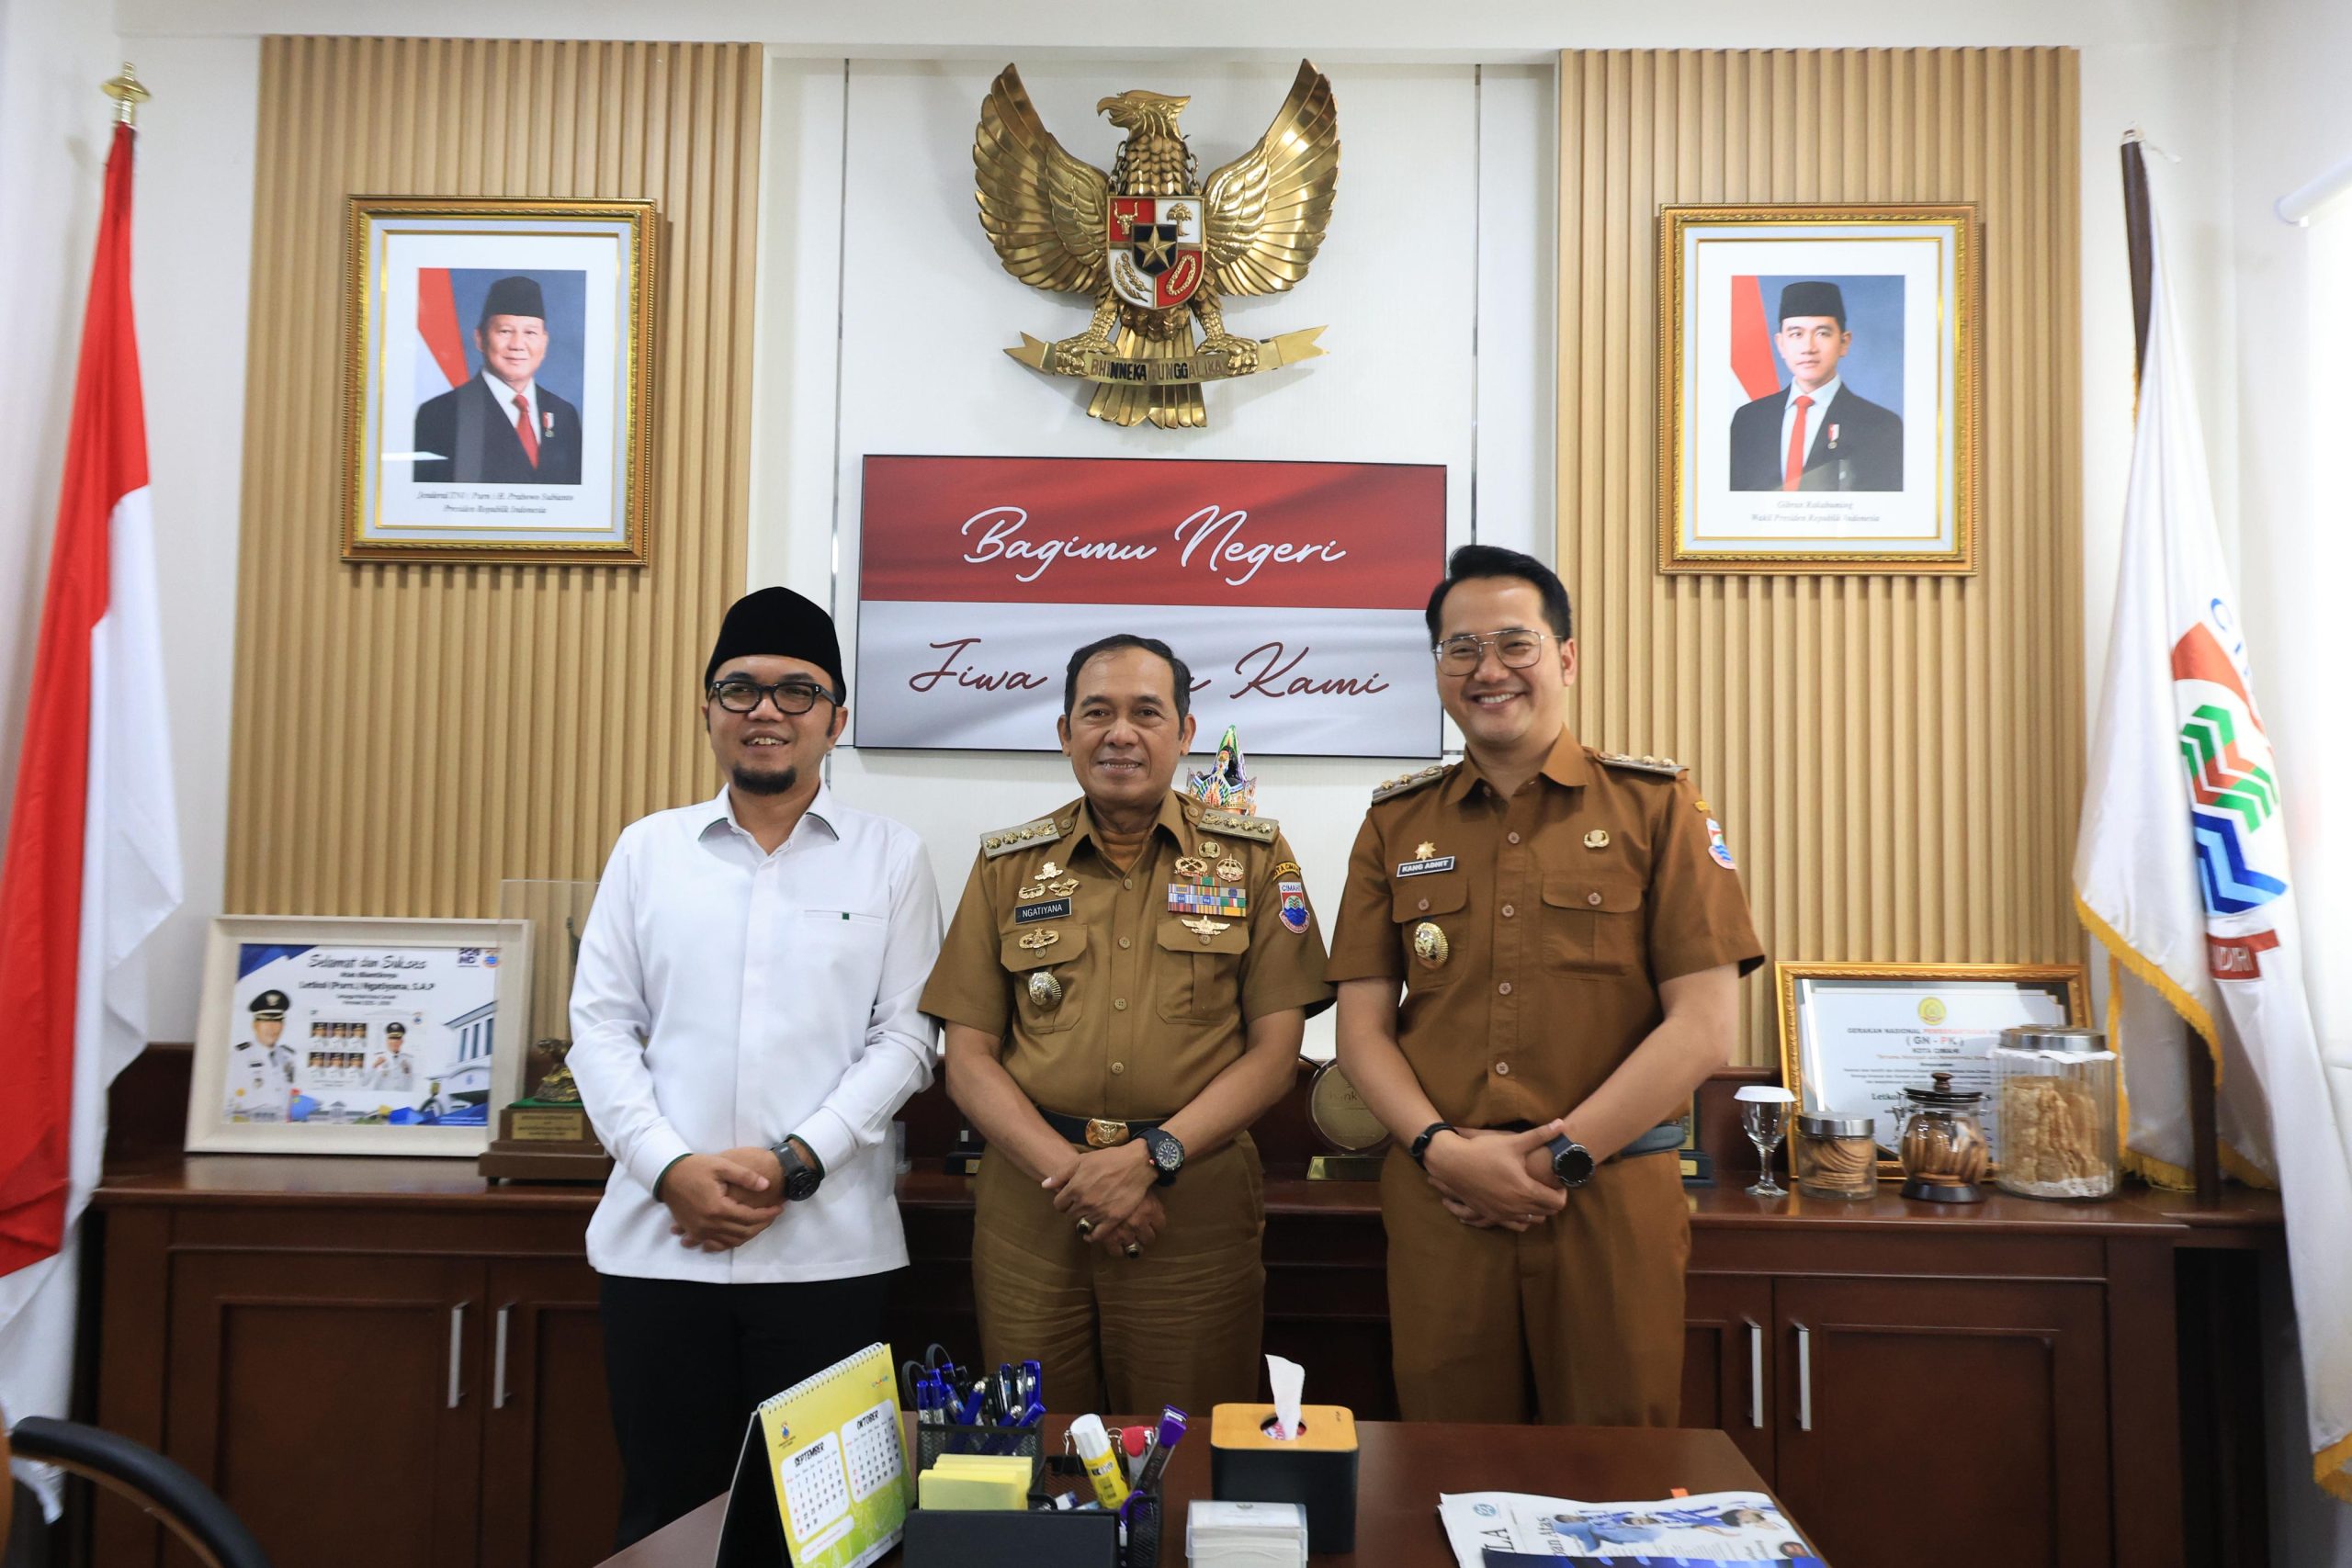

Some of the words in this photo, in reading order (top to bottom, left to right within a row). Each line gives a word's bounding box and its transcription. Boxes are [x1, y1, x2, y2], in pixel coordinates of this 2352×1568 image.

[1090, 357, 1148, 382] BHINNEKA
[961, 506, 1158, 583] Bagimu
[1174, 504, 1348, 586] Negeri
[909, 637, 1048, 693] Jiwa
[1229, 641, 1390, 700] Kami
[1402, 863, 1423, 873] KANG
[1022, 903, 1063, 919] NGATIYANA
[309, 953, 356, 968] Selamat
[381, 955, 427, 969] Sukses
[856, 1409, 879, 1430] OKTOBER
[794, 1441, 825, 1468] SEPTEMBER
